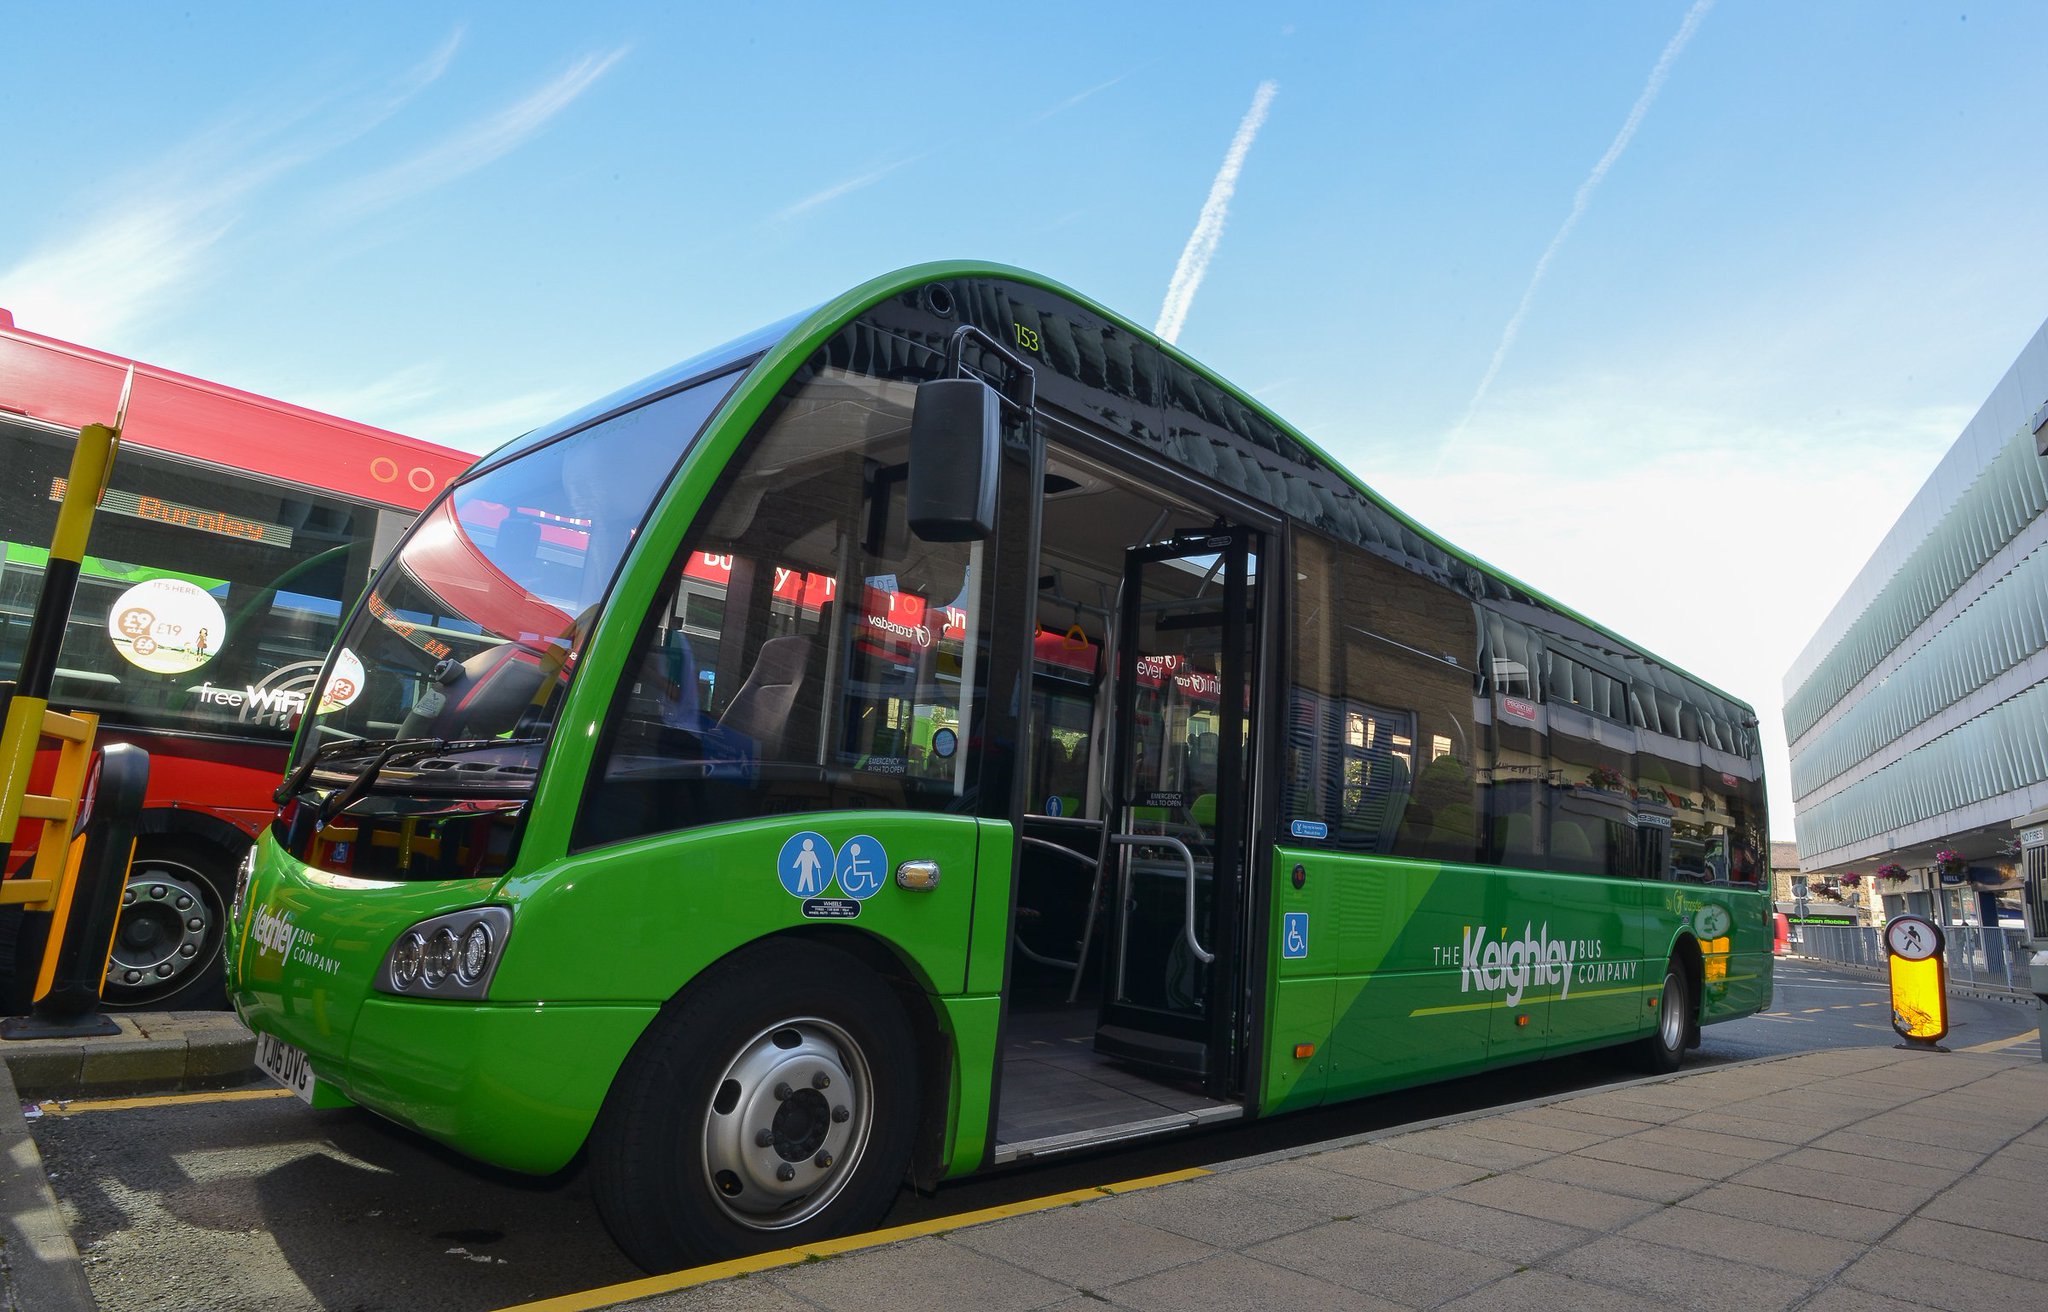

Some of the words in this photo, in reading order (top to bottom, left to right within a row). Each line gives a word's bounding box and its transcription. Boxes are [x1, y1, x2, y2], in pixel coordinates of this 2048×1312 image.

[1014, 323, 1039, 352] 153
[138, 496, 264, 541] Burnley
[157, 623, 182, 637] £19
[200, 682, 243, 707] free
[246, 685, 306, 715] WiFi
[868, 757, 900, 765] EMERGENCY
[1150, 792, 1182, 800] EMERGENCY
[2029, 829, 2043, 841] FIRES
[250, 903, 298, 966] Keighley
[298, 930, 316, 948] BUS
[293, 946, 341, 976] COMPANY
[1433, 945, 1459, 966] THE
[1461, 921, 1577, 1007] Keighley
[1579, 939, 1602, 959] BUS
[1578, 961, 1637, 984] COMPANY
[262, 1032, 285, 1074] YJ16
[283, 1045, 309, 1091] DVG
